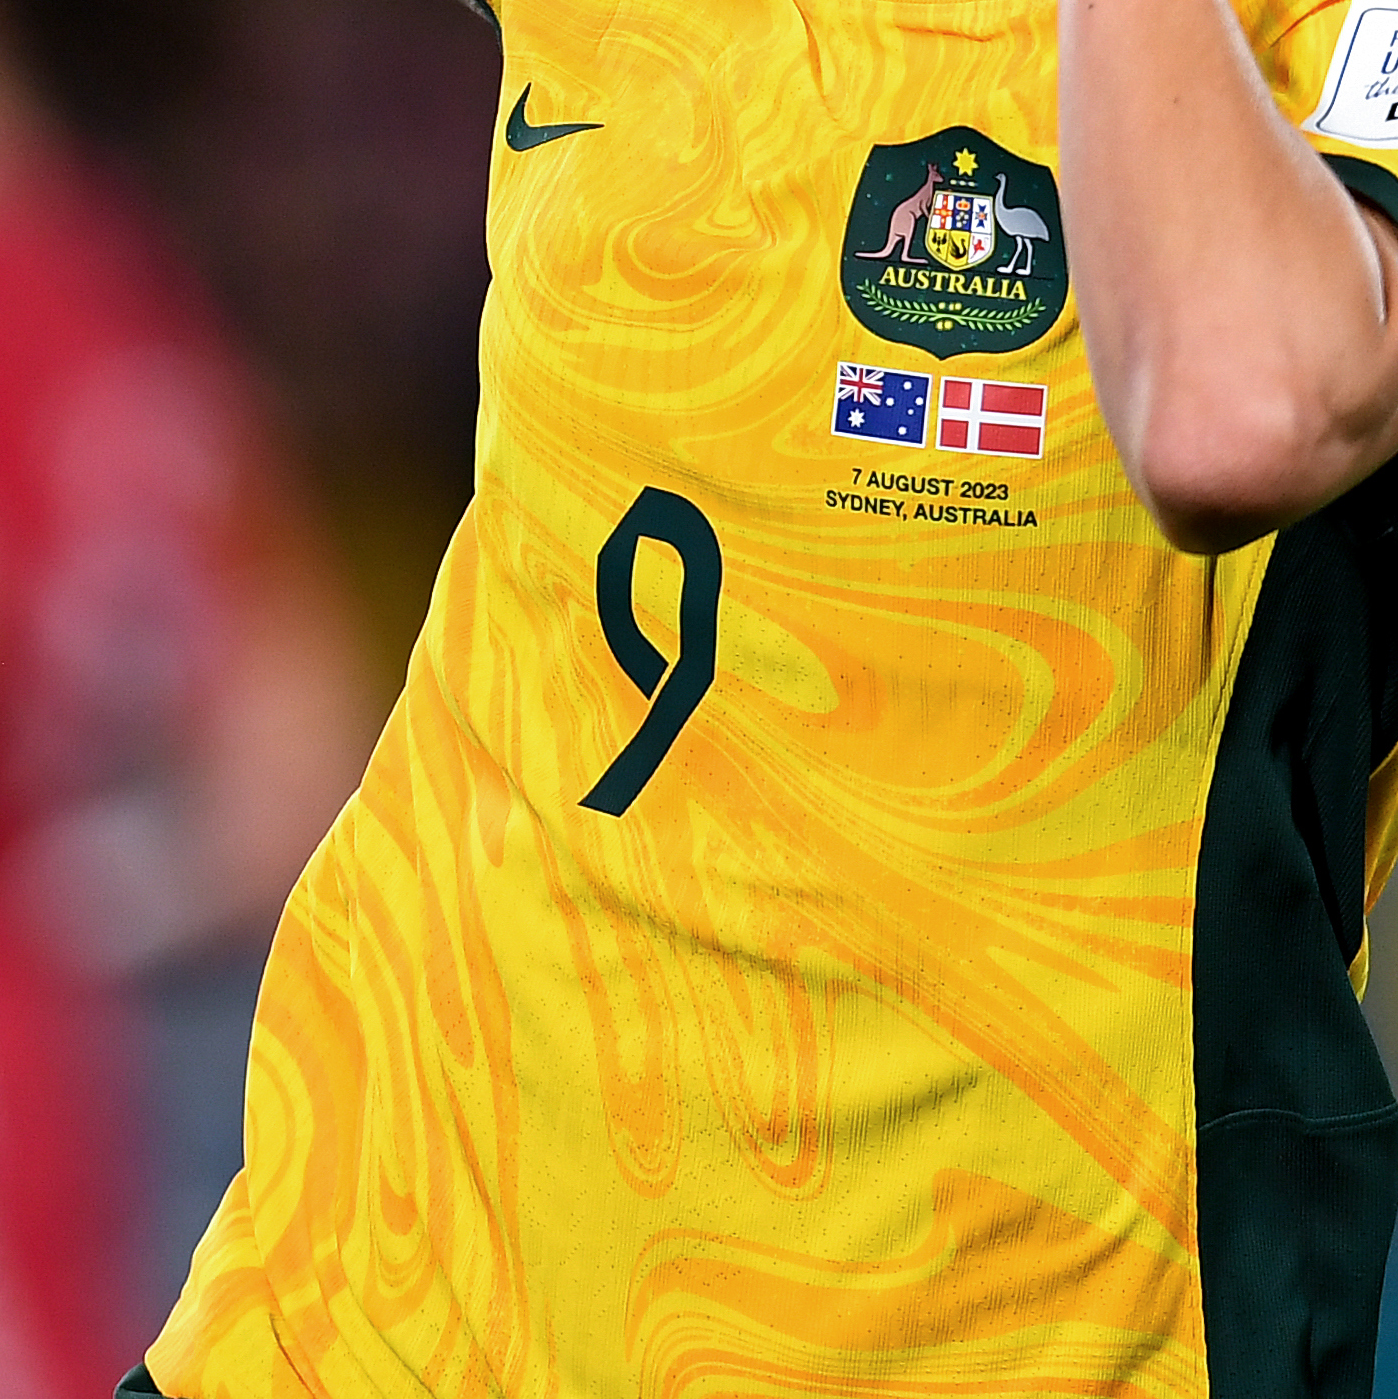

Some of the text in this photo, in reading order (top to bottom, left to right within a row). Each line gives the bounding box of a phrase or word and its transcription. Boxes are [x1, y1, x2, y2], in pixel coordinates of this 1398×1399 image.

[879, 265, 1027, 301] AUSTRALIA
[851, 467, 1009, 501] 7 AUGUST 2023
[825, 489, 1038, 528] SYDNEY, AUSTRALIA
[577, 485, 723, 818] 9
